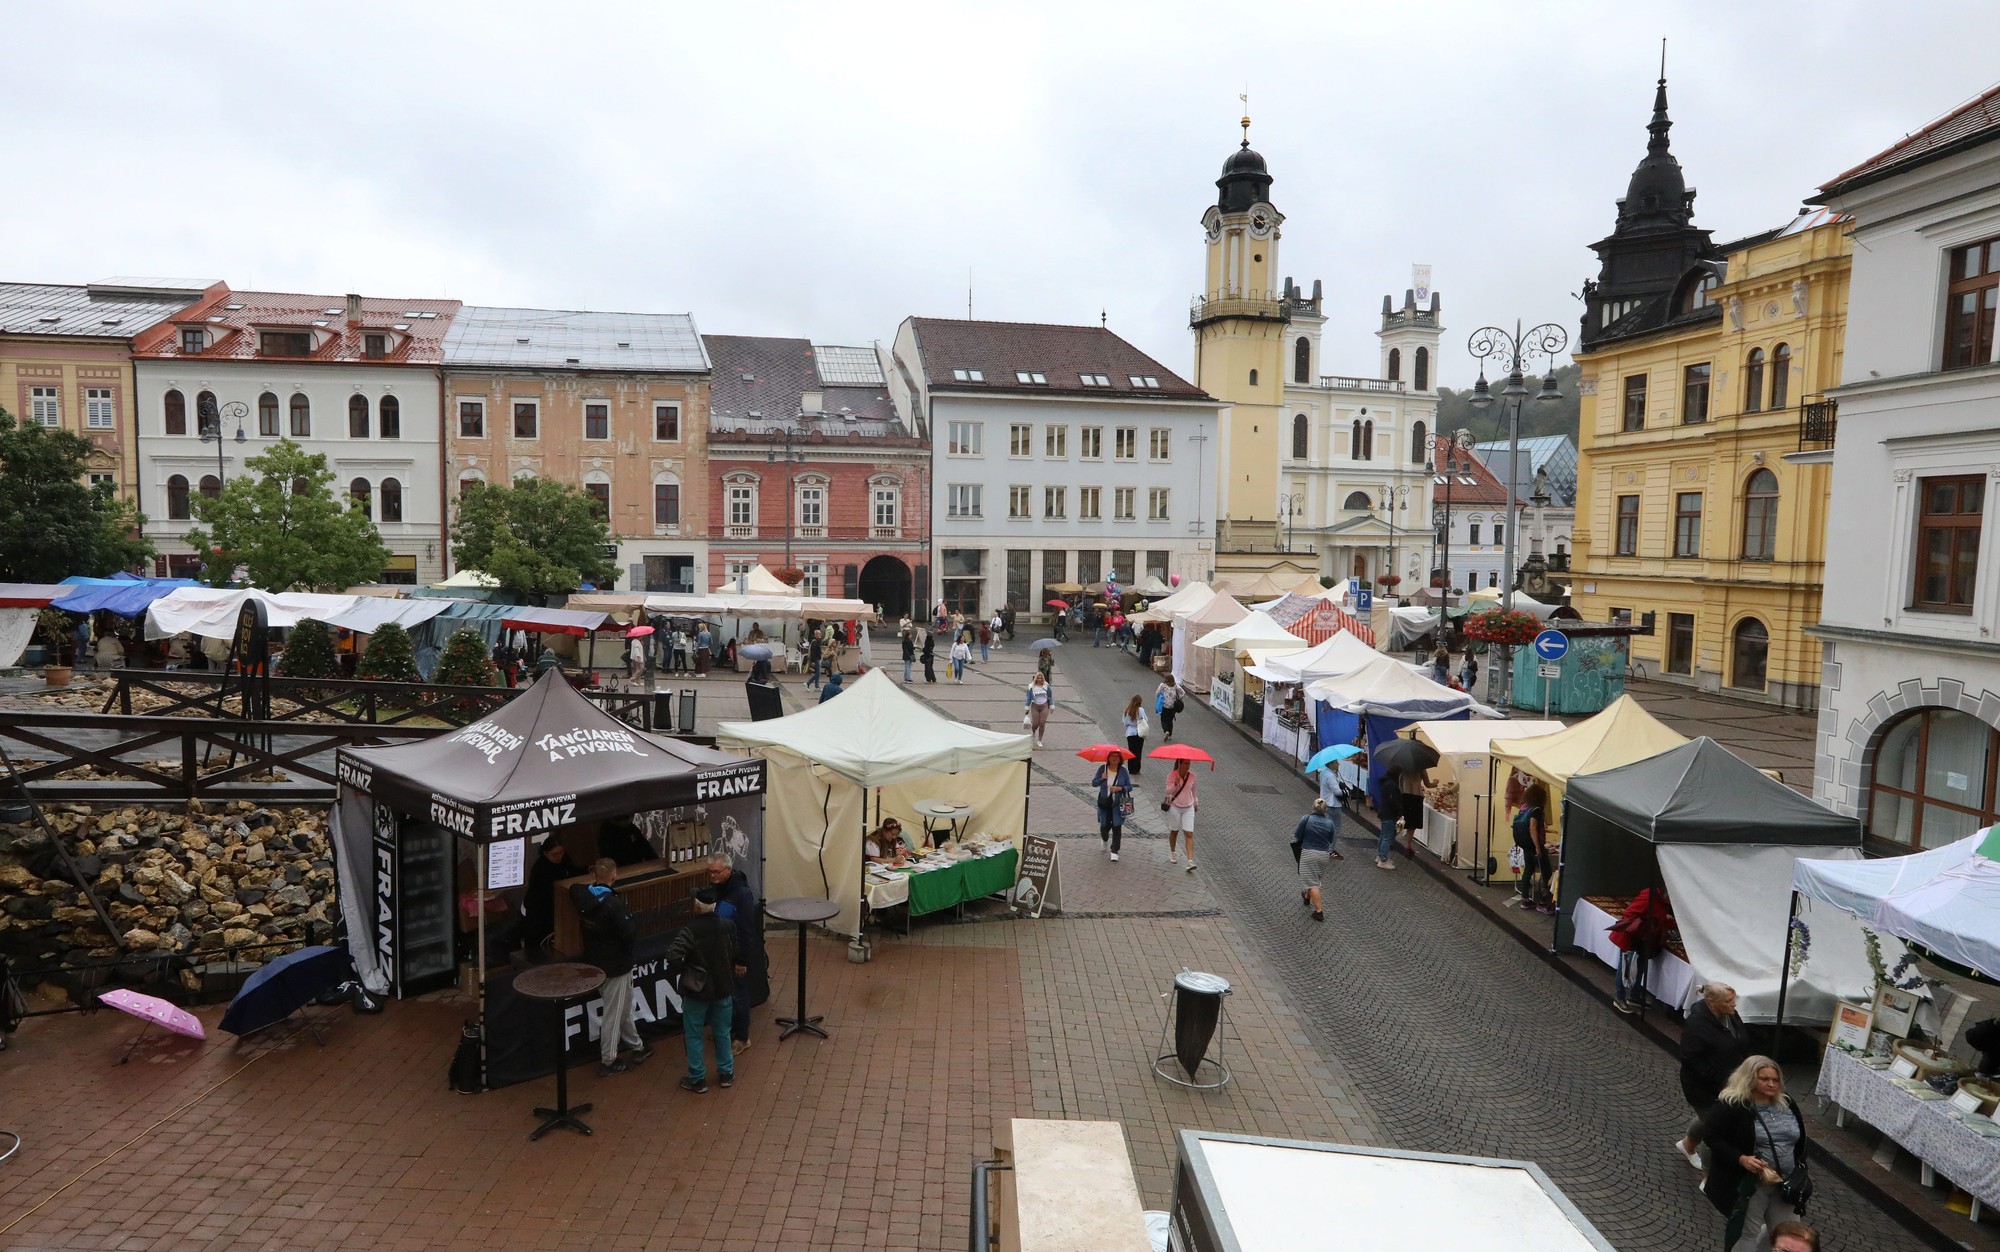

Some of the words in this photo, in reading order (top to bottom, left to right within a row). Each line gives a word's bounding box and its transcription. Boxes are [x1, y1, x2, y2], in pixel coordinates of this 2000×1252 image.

[1361, 592, 1368, 605] P
[534, 727, 635, 751] TANČIAREŇ
[550, 750, 565, 763] A
[565, 741, 649, 758] PIVOVAR
[338, 762, 372, 794] FRANZ
[696, 773, 761, 801] FRANZ
[491, 799, 545, 815] REŠTAURAČNÝ
[546, 793, 577, 804] PIVOVAR
[430, 802, 475, 838] FRANZ
[491, 803, 577, 838] FRANZ
[377, 847, 393, 983] FRANZ
[564, 973, 684, 1052] FRAN
